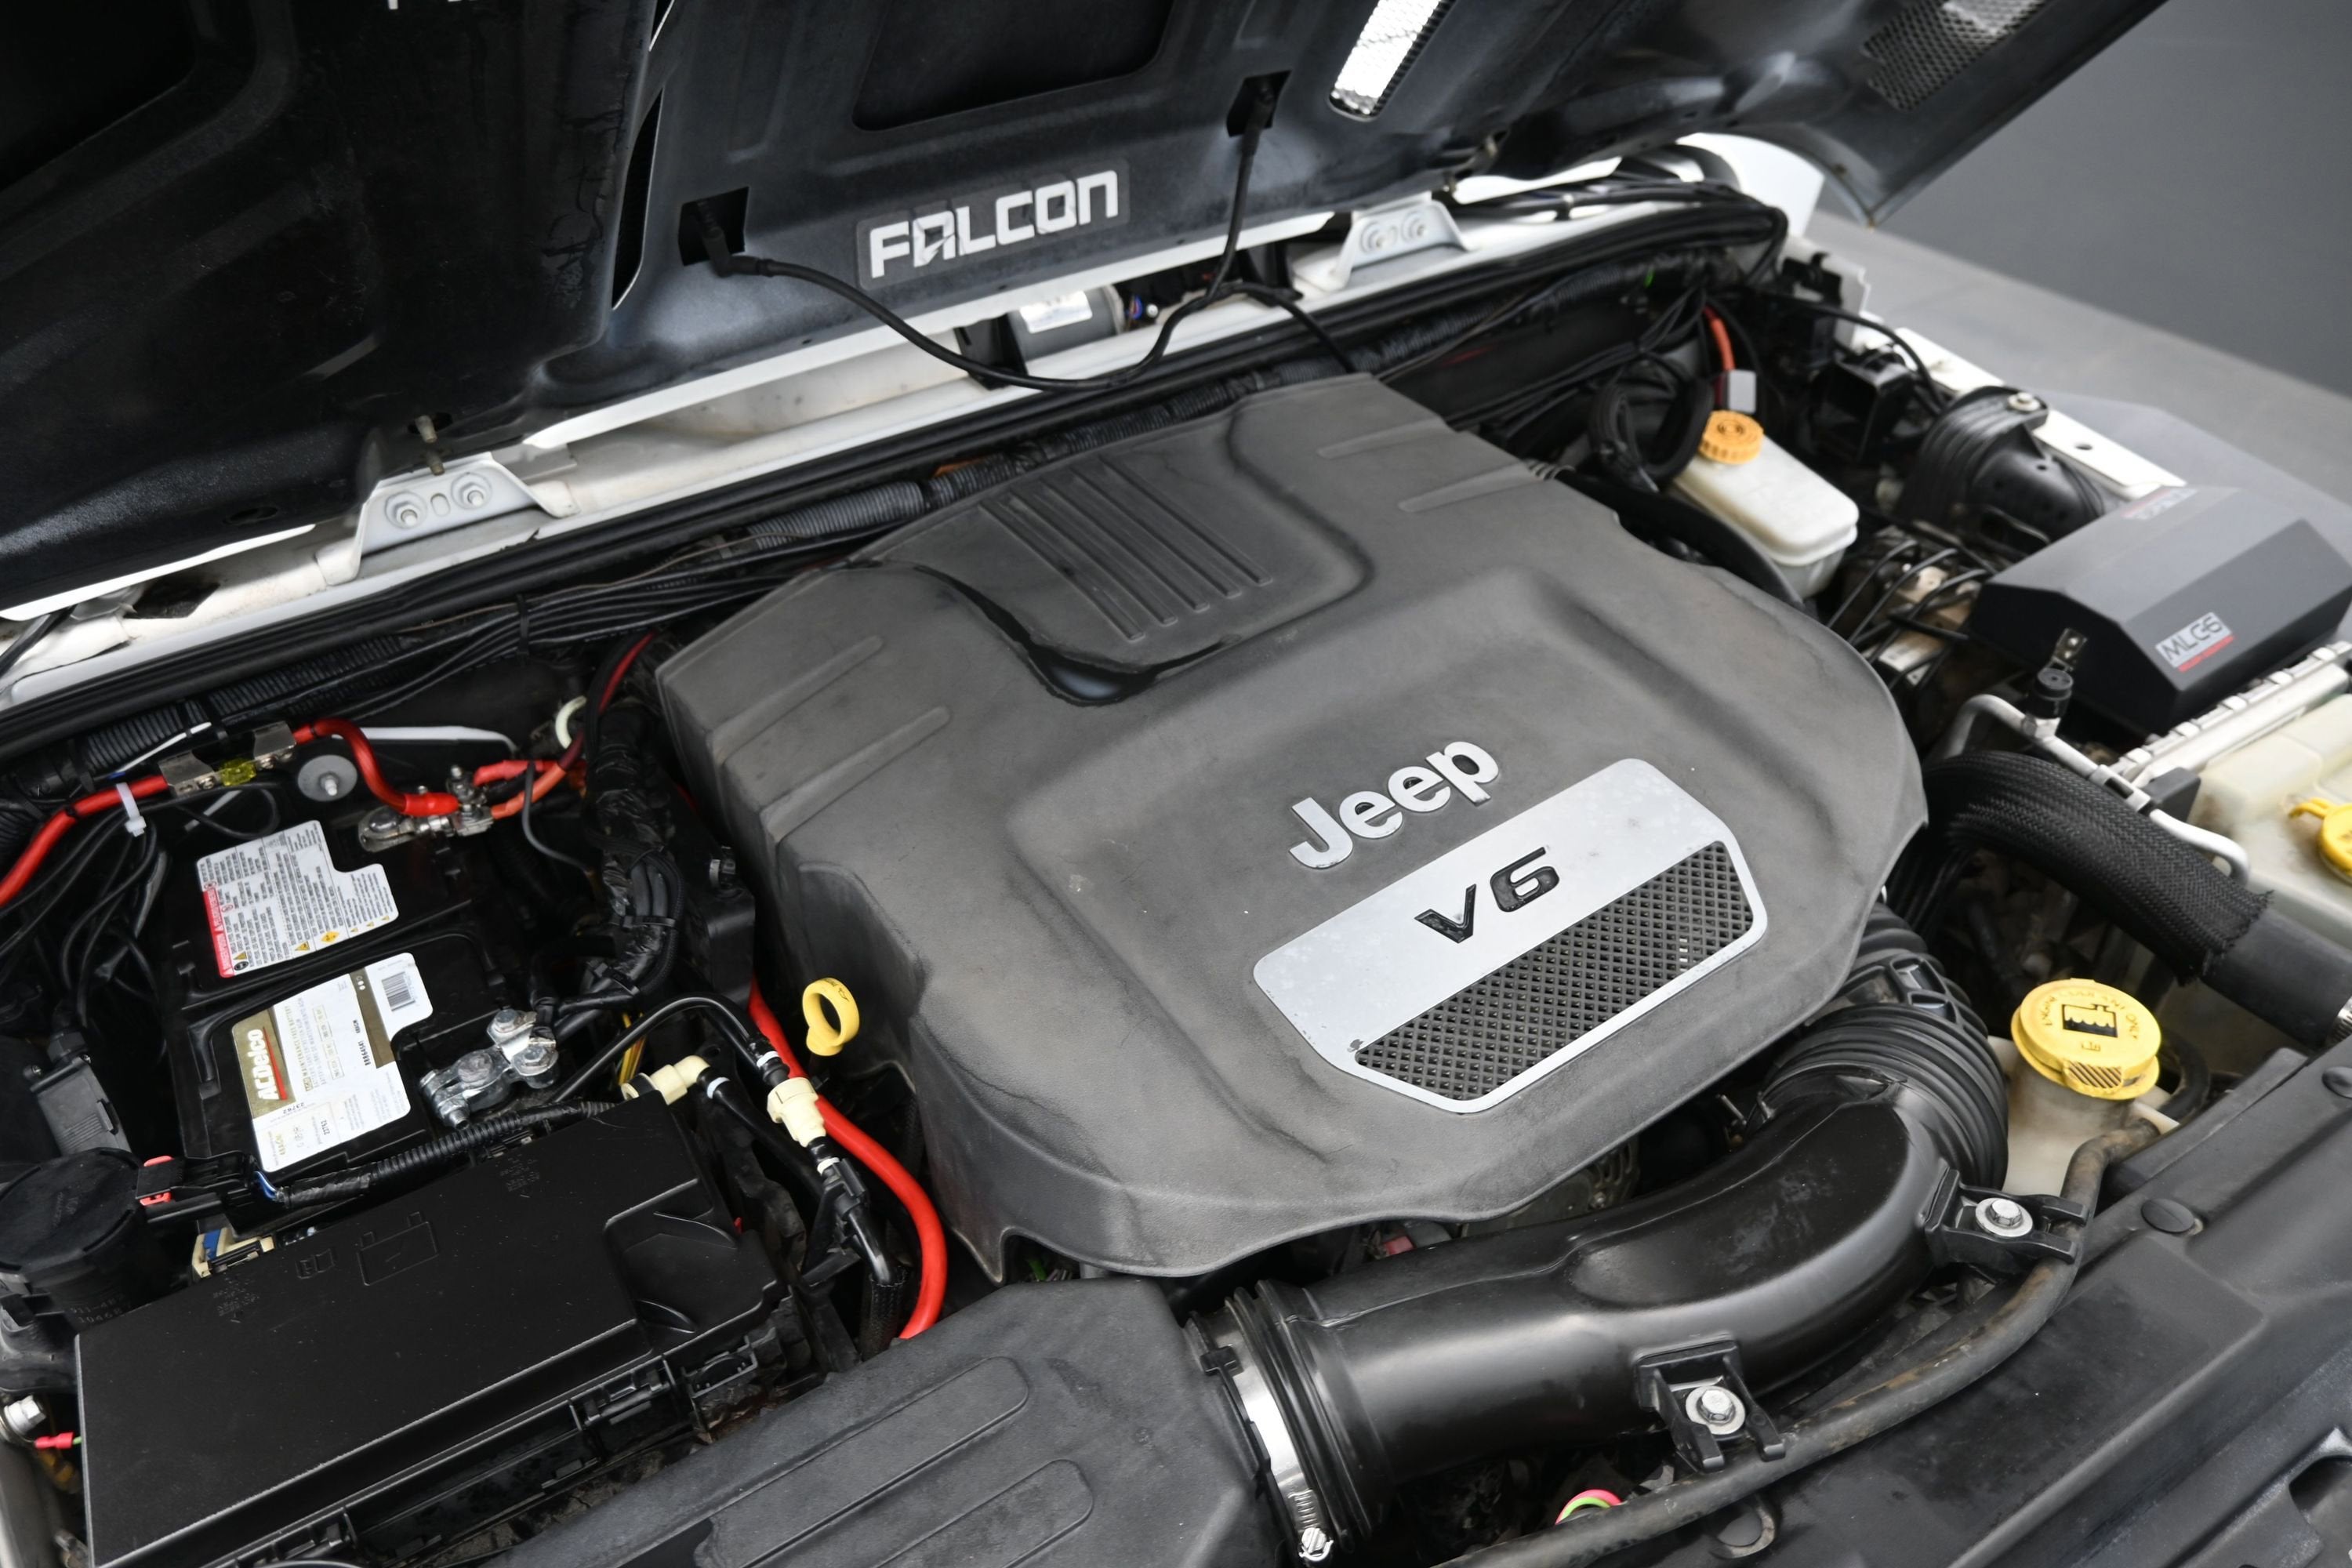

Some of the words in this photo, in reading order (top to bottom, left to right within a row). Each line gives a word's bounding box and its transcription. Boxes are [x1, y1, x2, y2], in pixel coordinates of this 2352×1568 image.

[870, 170, 1119, 278] FALCON
[1288, 741, 1499, 869] Jeep
[1414, 846, 1560, 944] V6
[247, 1029, 278, 1101] ACDelco
